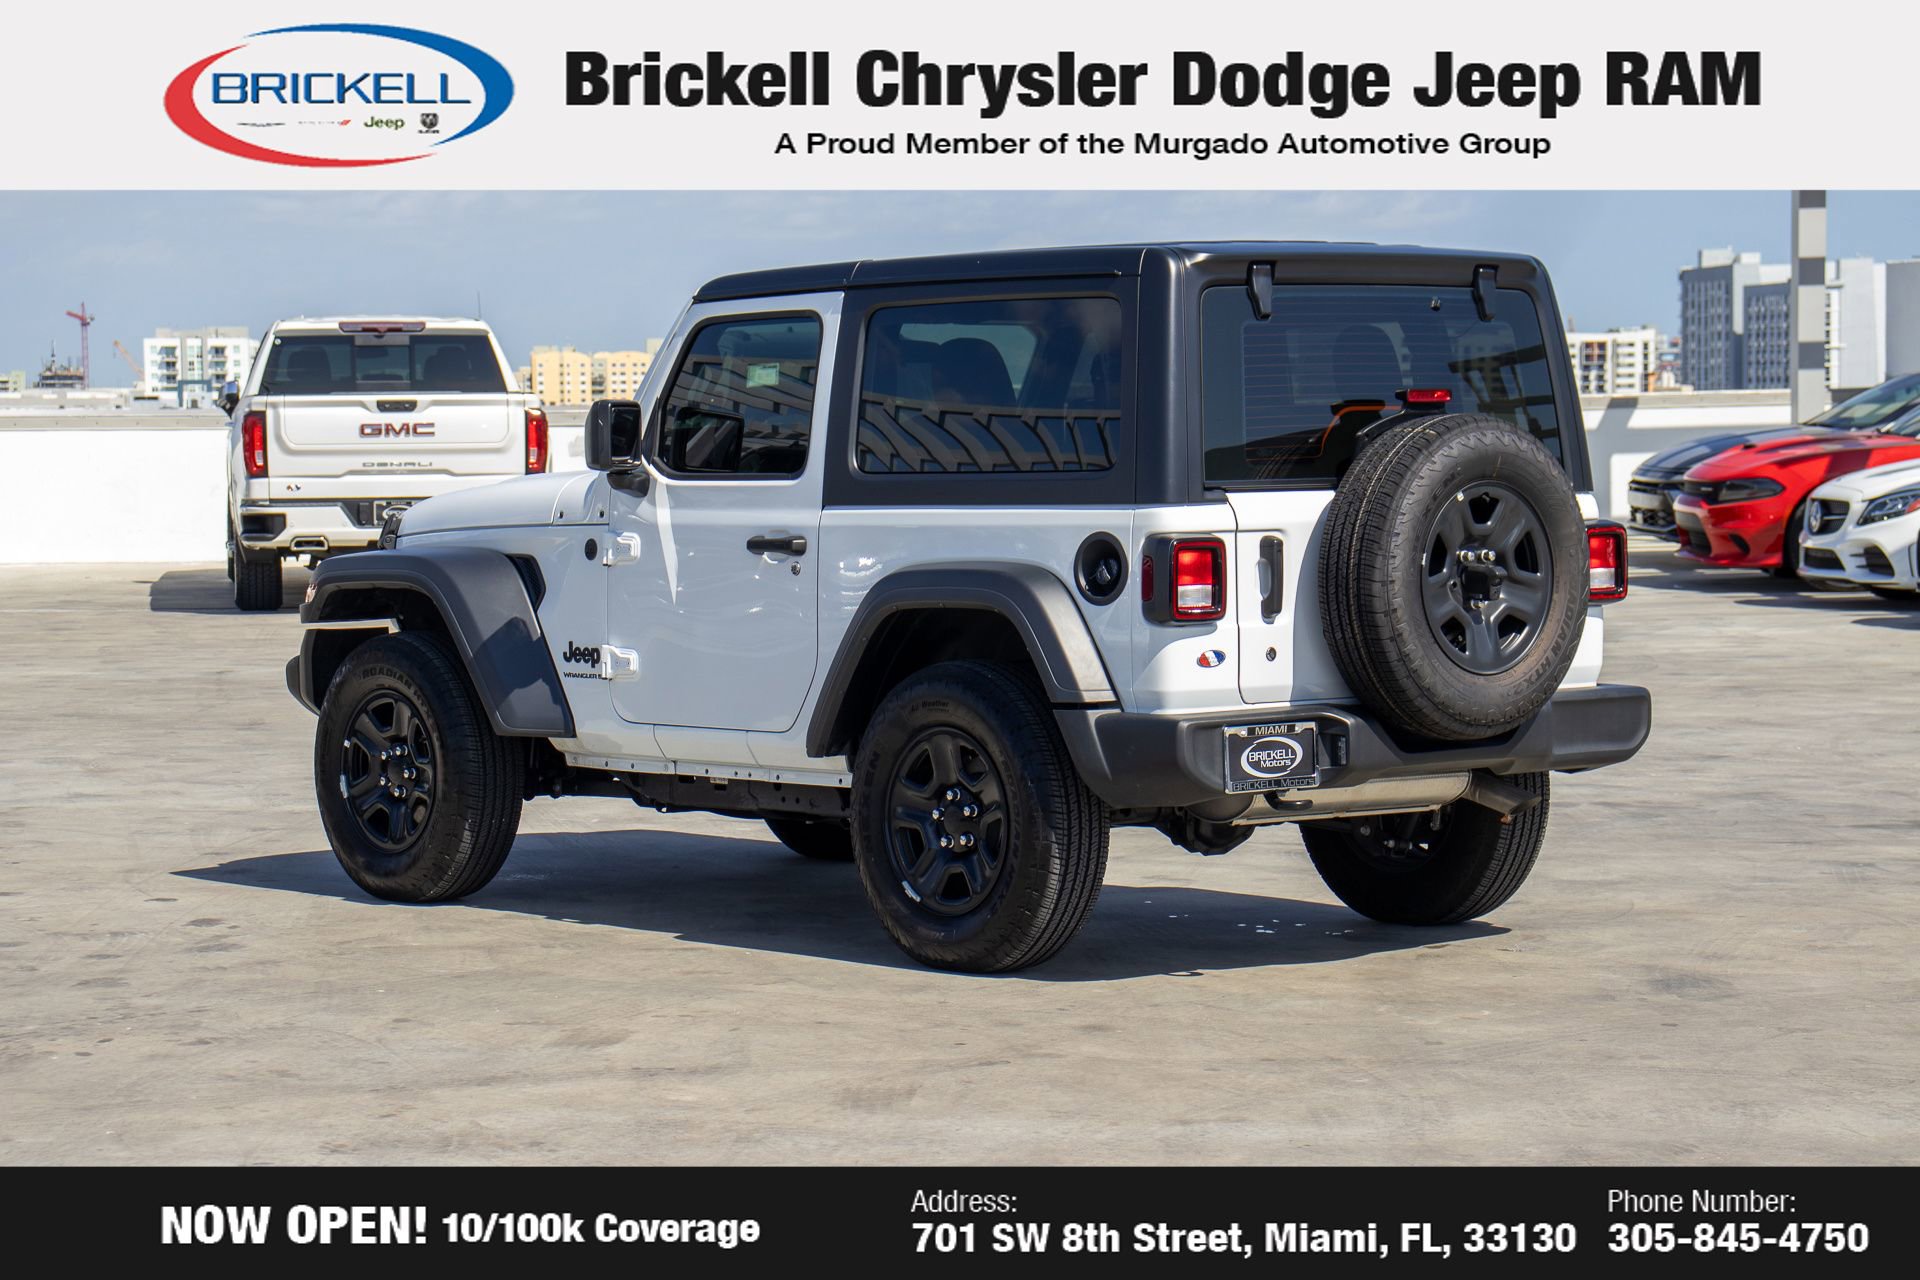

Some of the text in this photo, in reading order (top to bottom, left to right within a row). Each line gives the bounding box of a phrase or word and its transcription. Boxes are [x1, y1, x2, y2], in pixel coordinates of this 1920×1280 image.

[359, 422, 435, 438] GMC
[562, 640, 601, 668] Jeep
[563, 671, 598, 680] WRANGLER
[1255, 725, 1288, 736] MIAMI
[1248, 749, 1296, 762] BRICKELL
[1260, 759, 1292, 769] Motors
[1233, 777, 1315, 792] BRICKELL Motors
